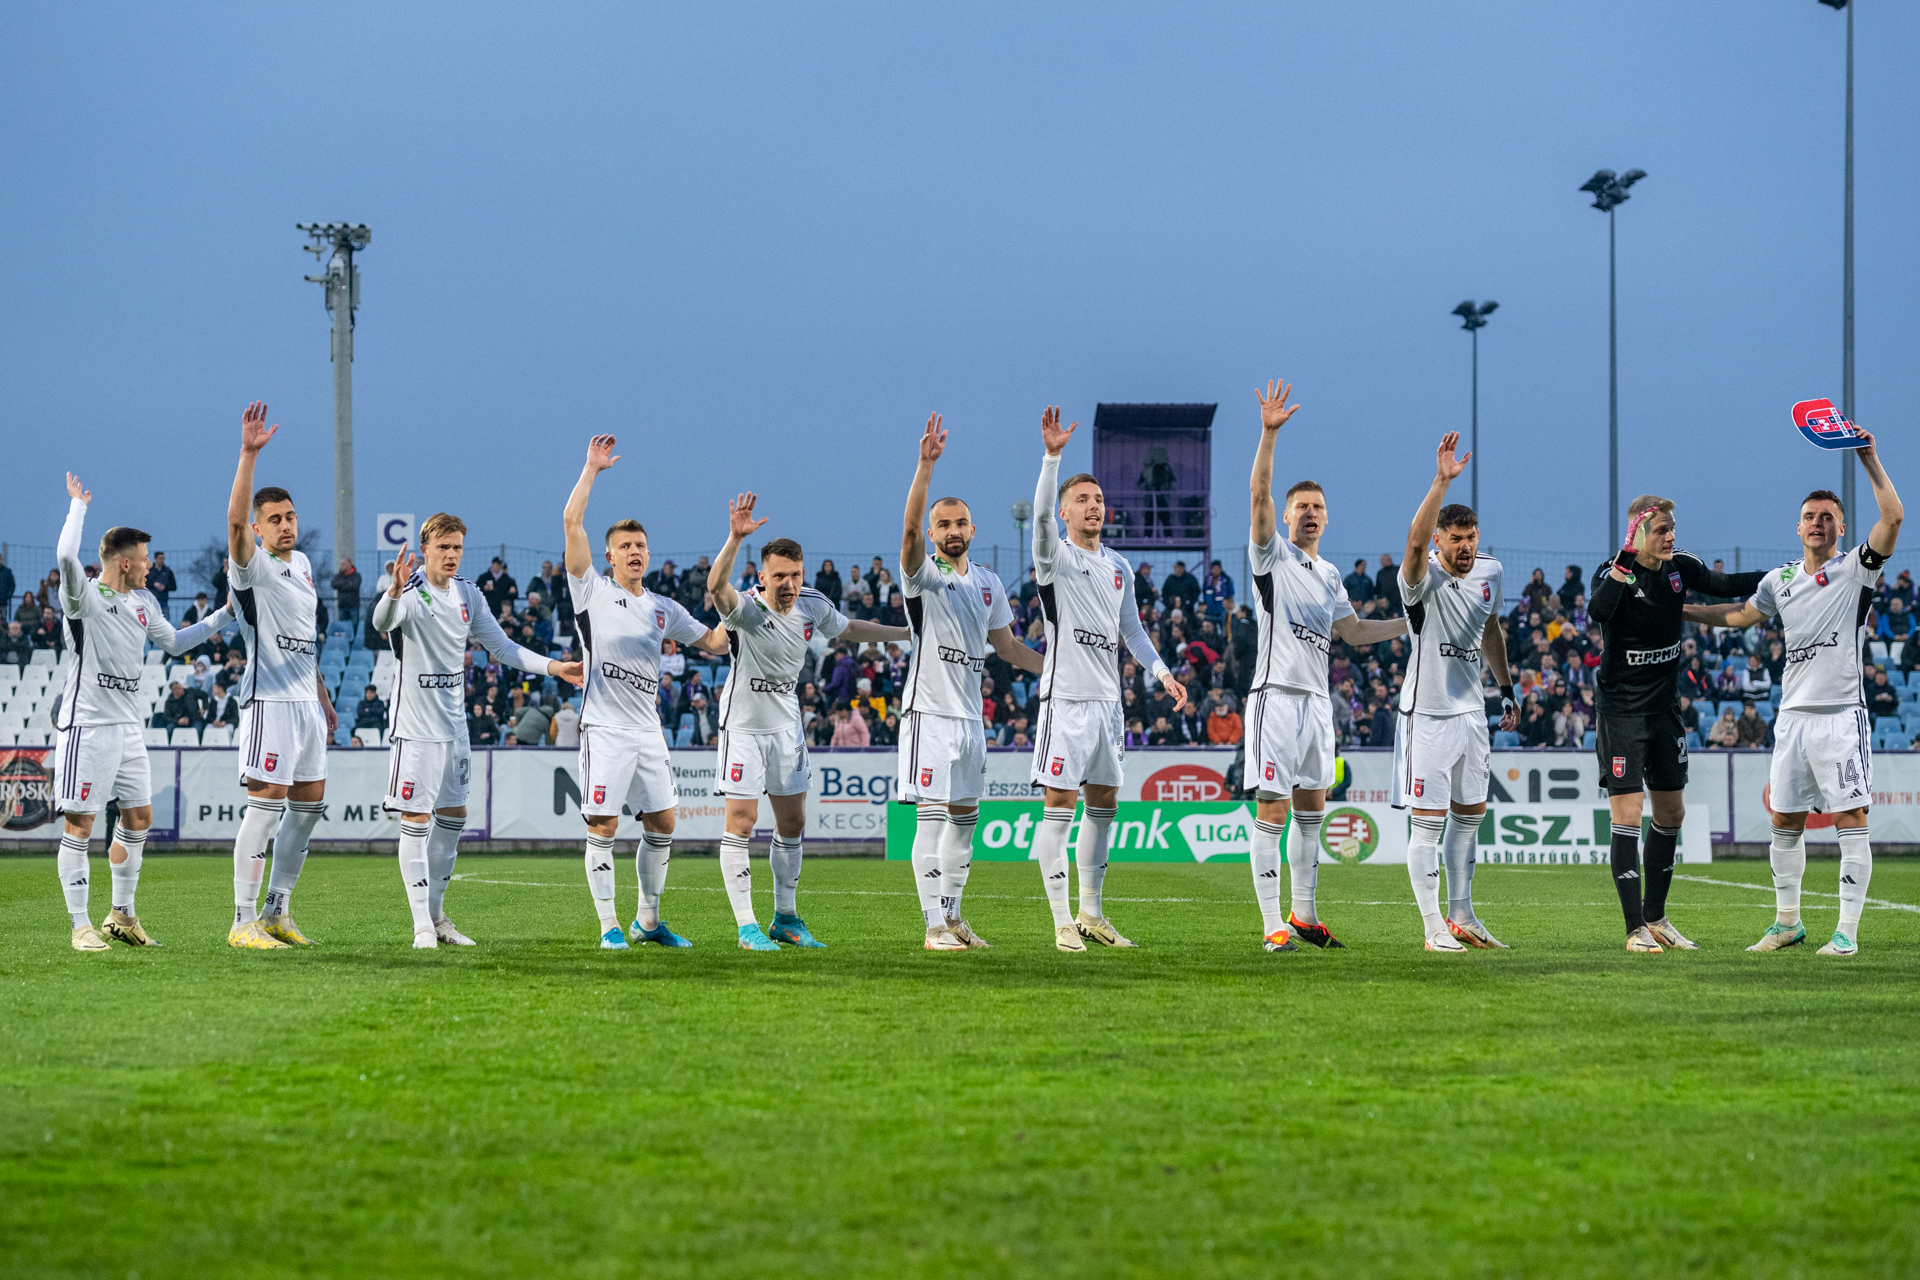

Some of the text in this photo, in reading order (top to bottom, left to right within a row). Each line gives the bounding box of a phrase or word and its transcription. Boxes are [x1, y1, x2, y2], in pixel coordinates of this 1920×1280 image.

[384, 519, 408, 545] C
[1836, 759, 1860, 789] 14
[677, 784, 713, 797] ános
[1196, 824, 1249, 841] LIGA
